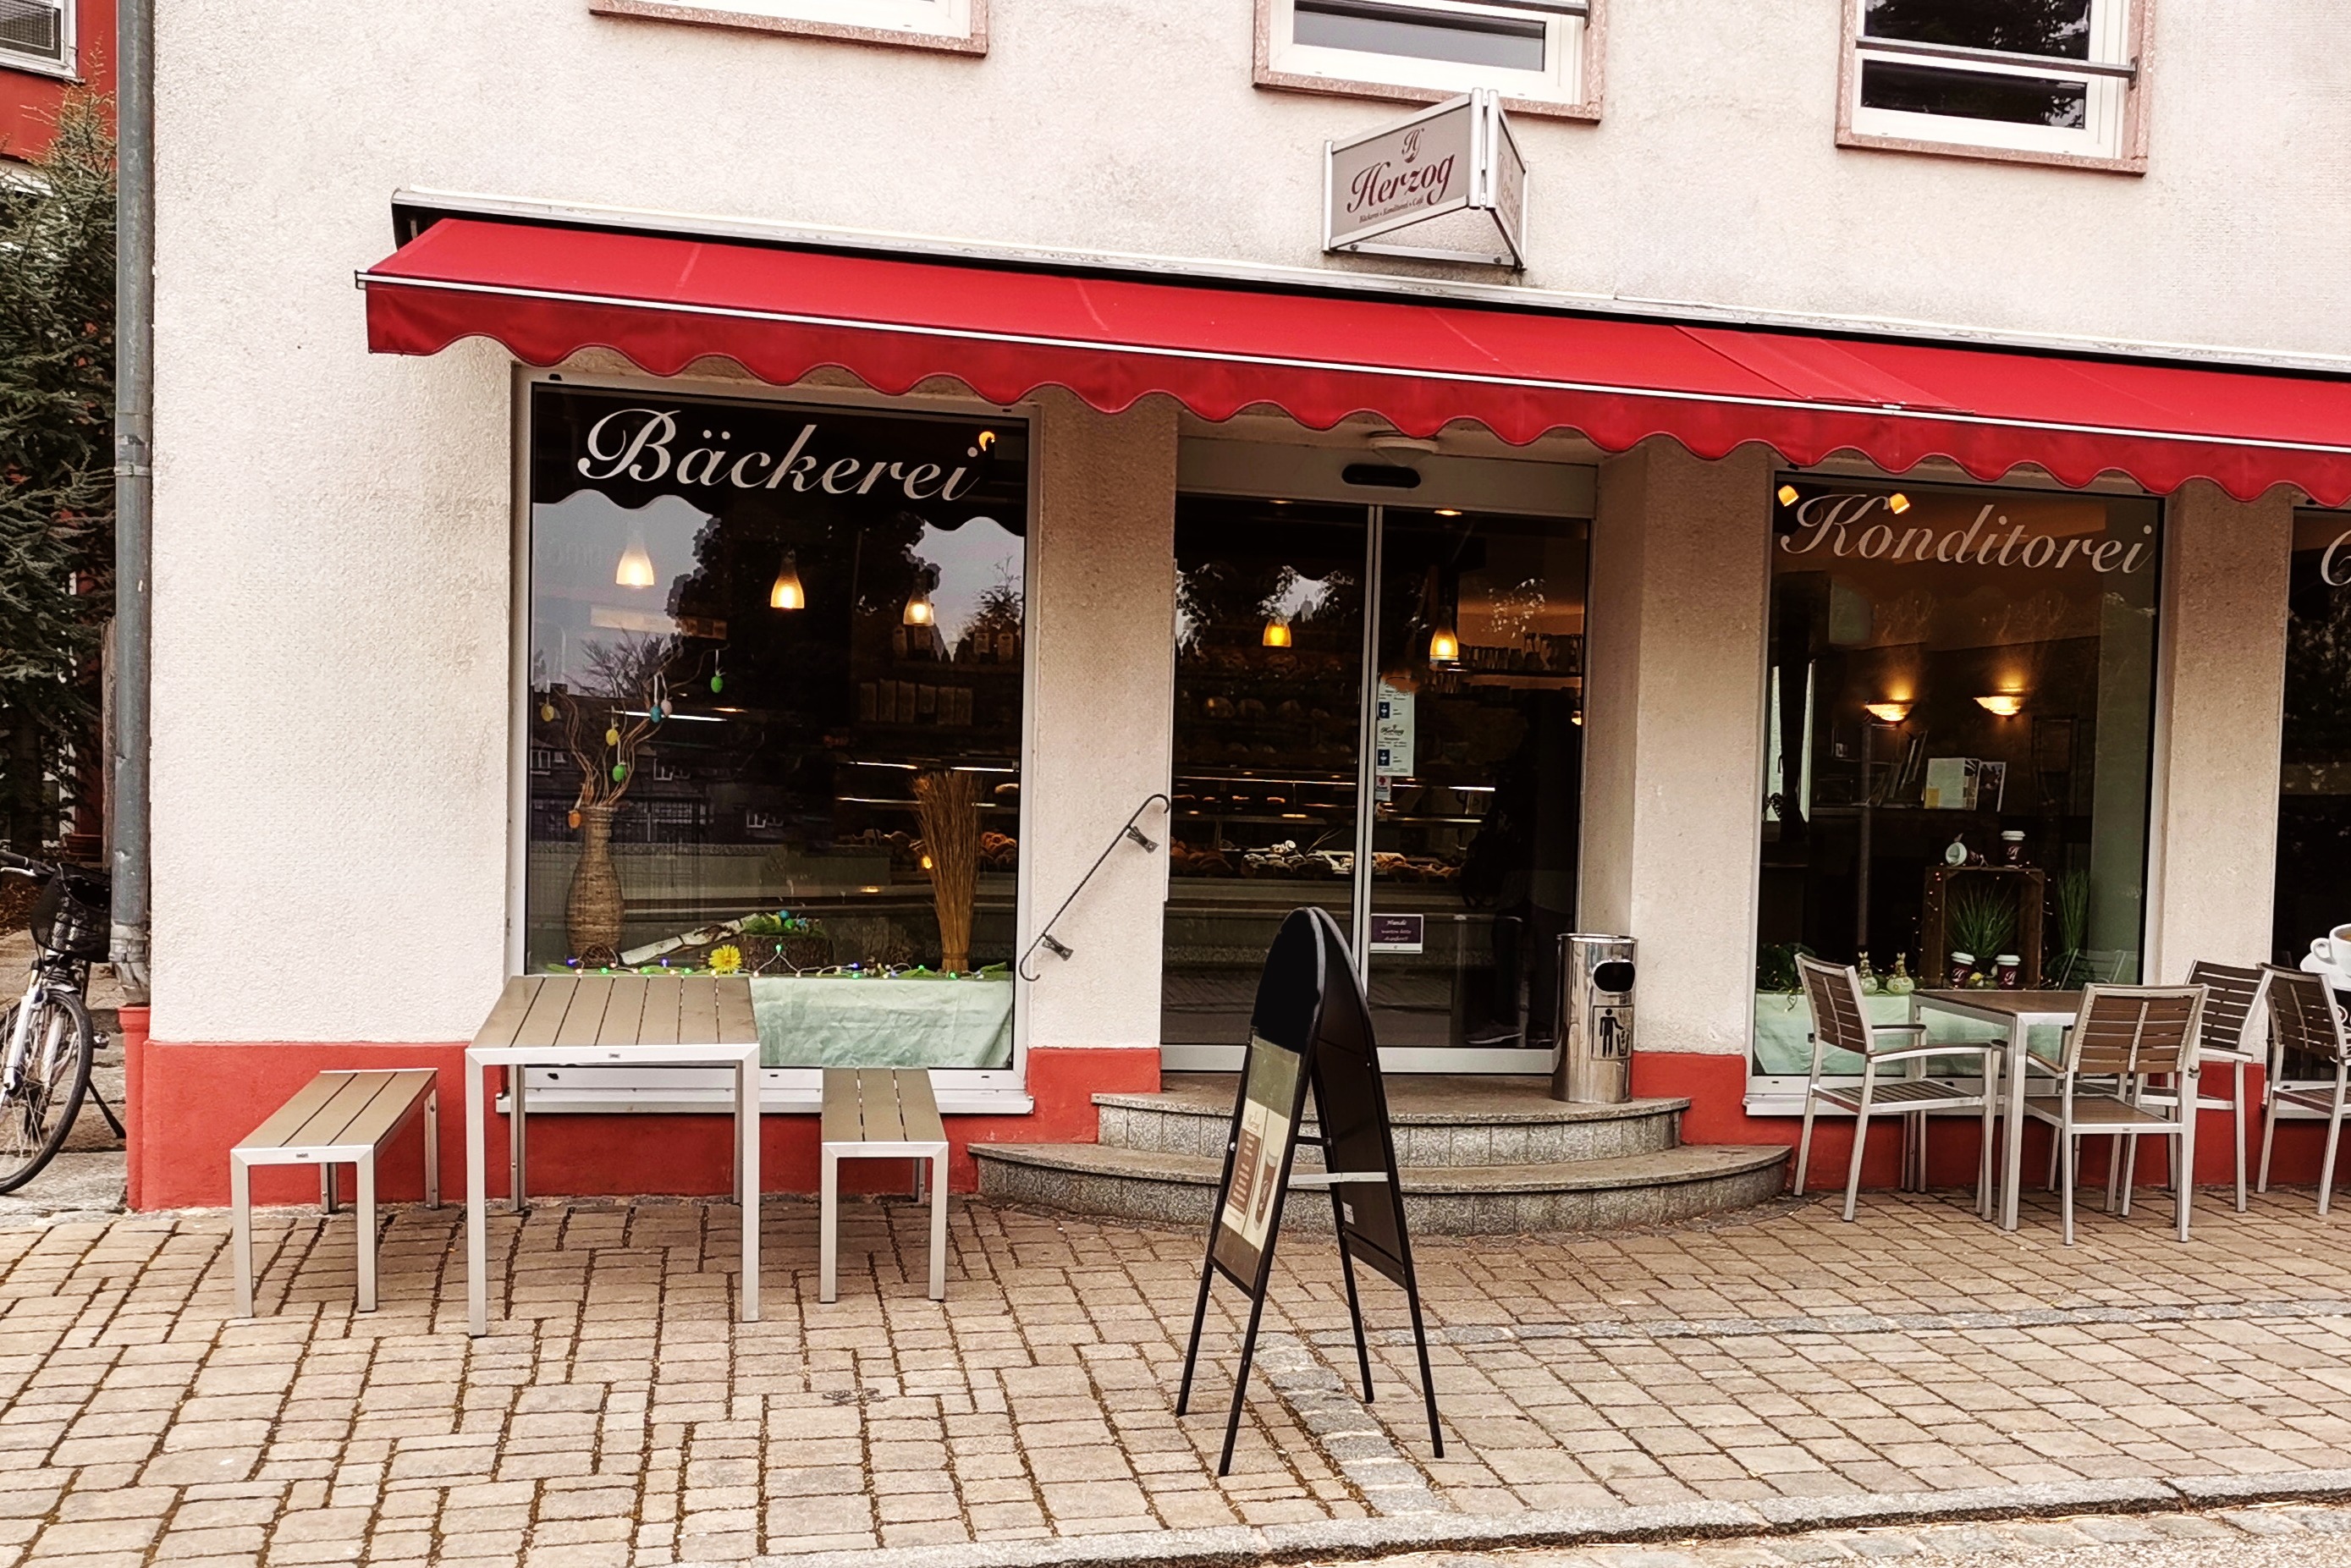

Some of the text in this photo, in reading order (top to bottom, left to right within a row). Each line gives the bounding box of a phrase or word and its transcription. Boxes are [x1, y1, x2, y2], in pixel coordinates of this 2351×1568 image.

[1346, 154, 1456, 213] Herzog
[577, 408, 980, 501] Bäckerei
[1780, 493, 2153, 575] Konditorei
